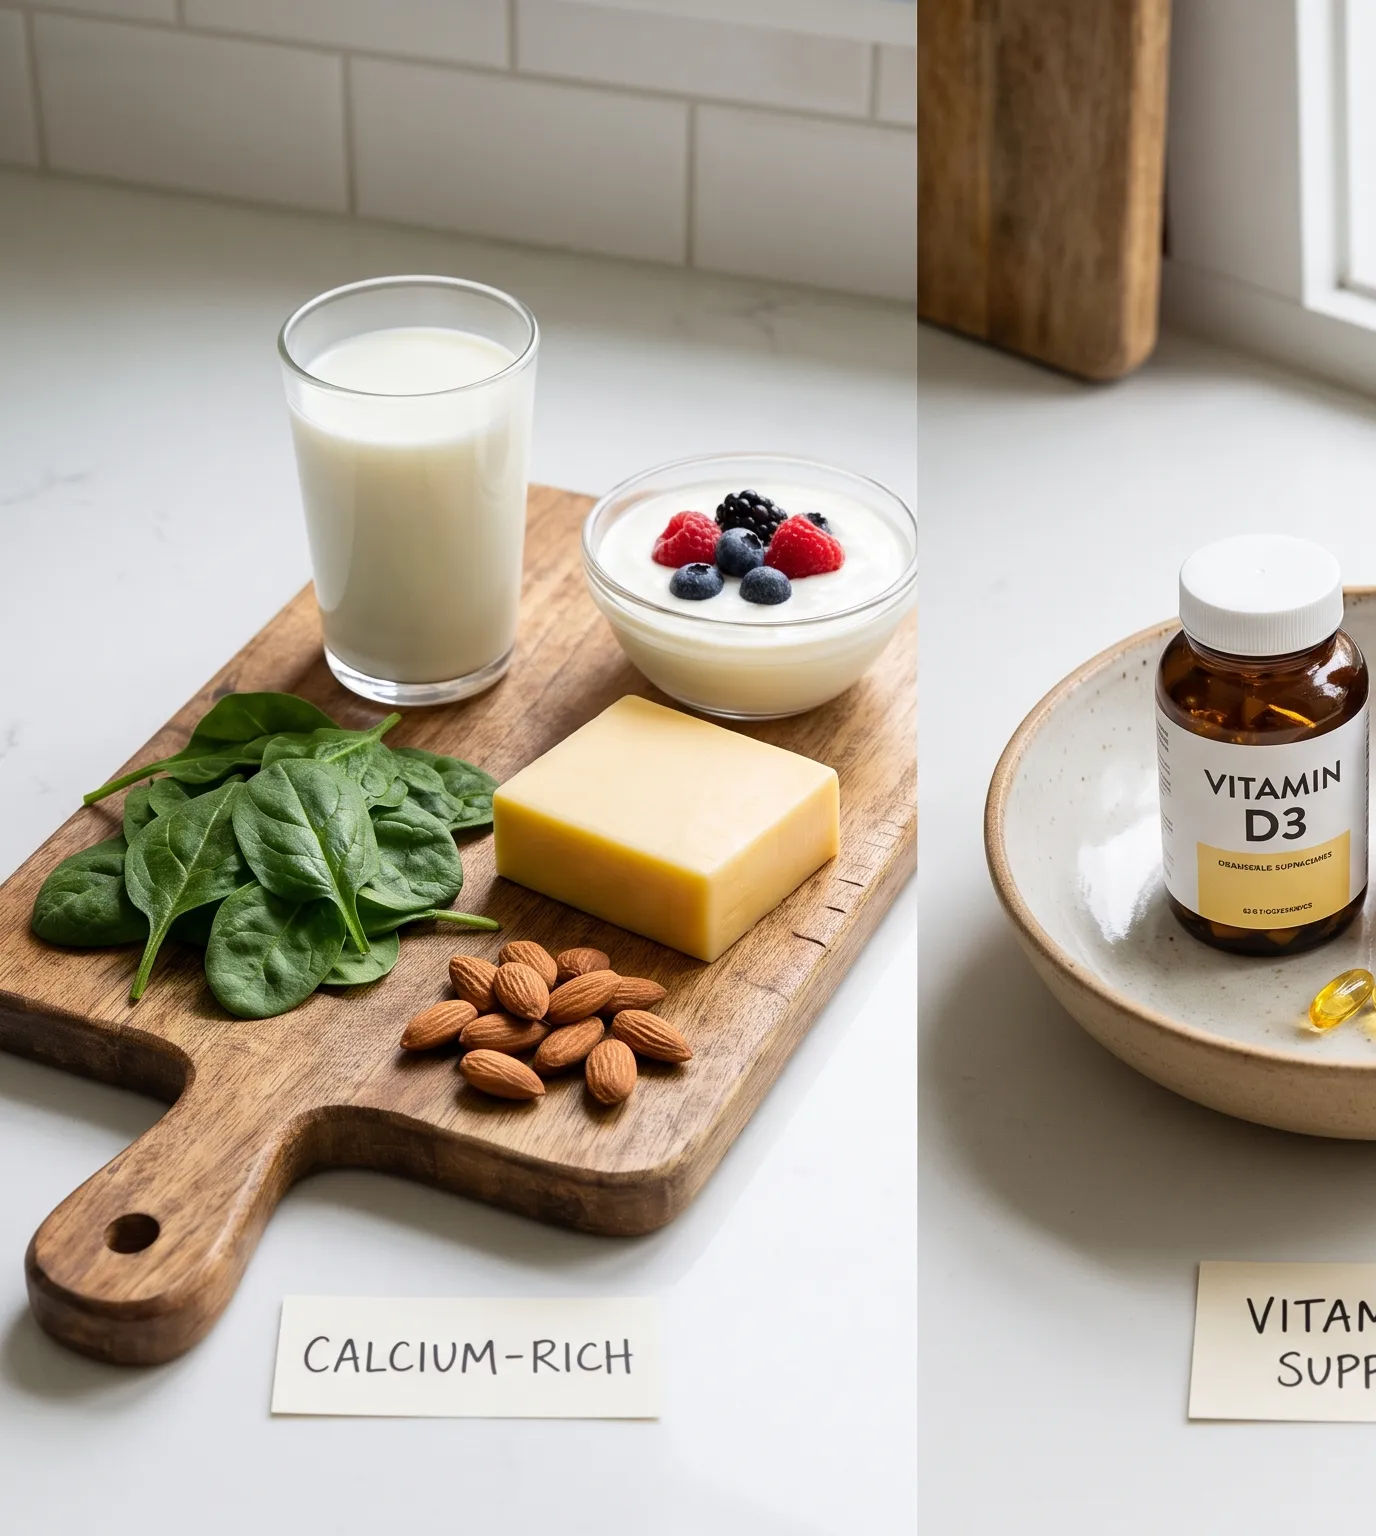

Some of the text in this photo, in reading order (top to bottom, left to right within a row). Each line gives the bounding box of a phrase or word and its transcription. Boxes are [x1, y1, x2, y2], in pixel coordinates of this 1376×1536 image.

[1204, 760, 1341, 800] VITAMIN
[1245, 807, 1307, 842] D3
[303, 1336, 634, 1375] CALCIUM-RICH
